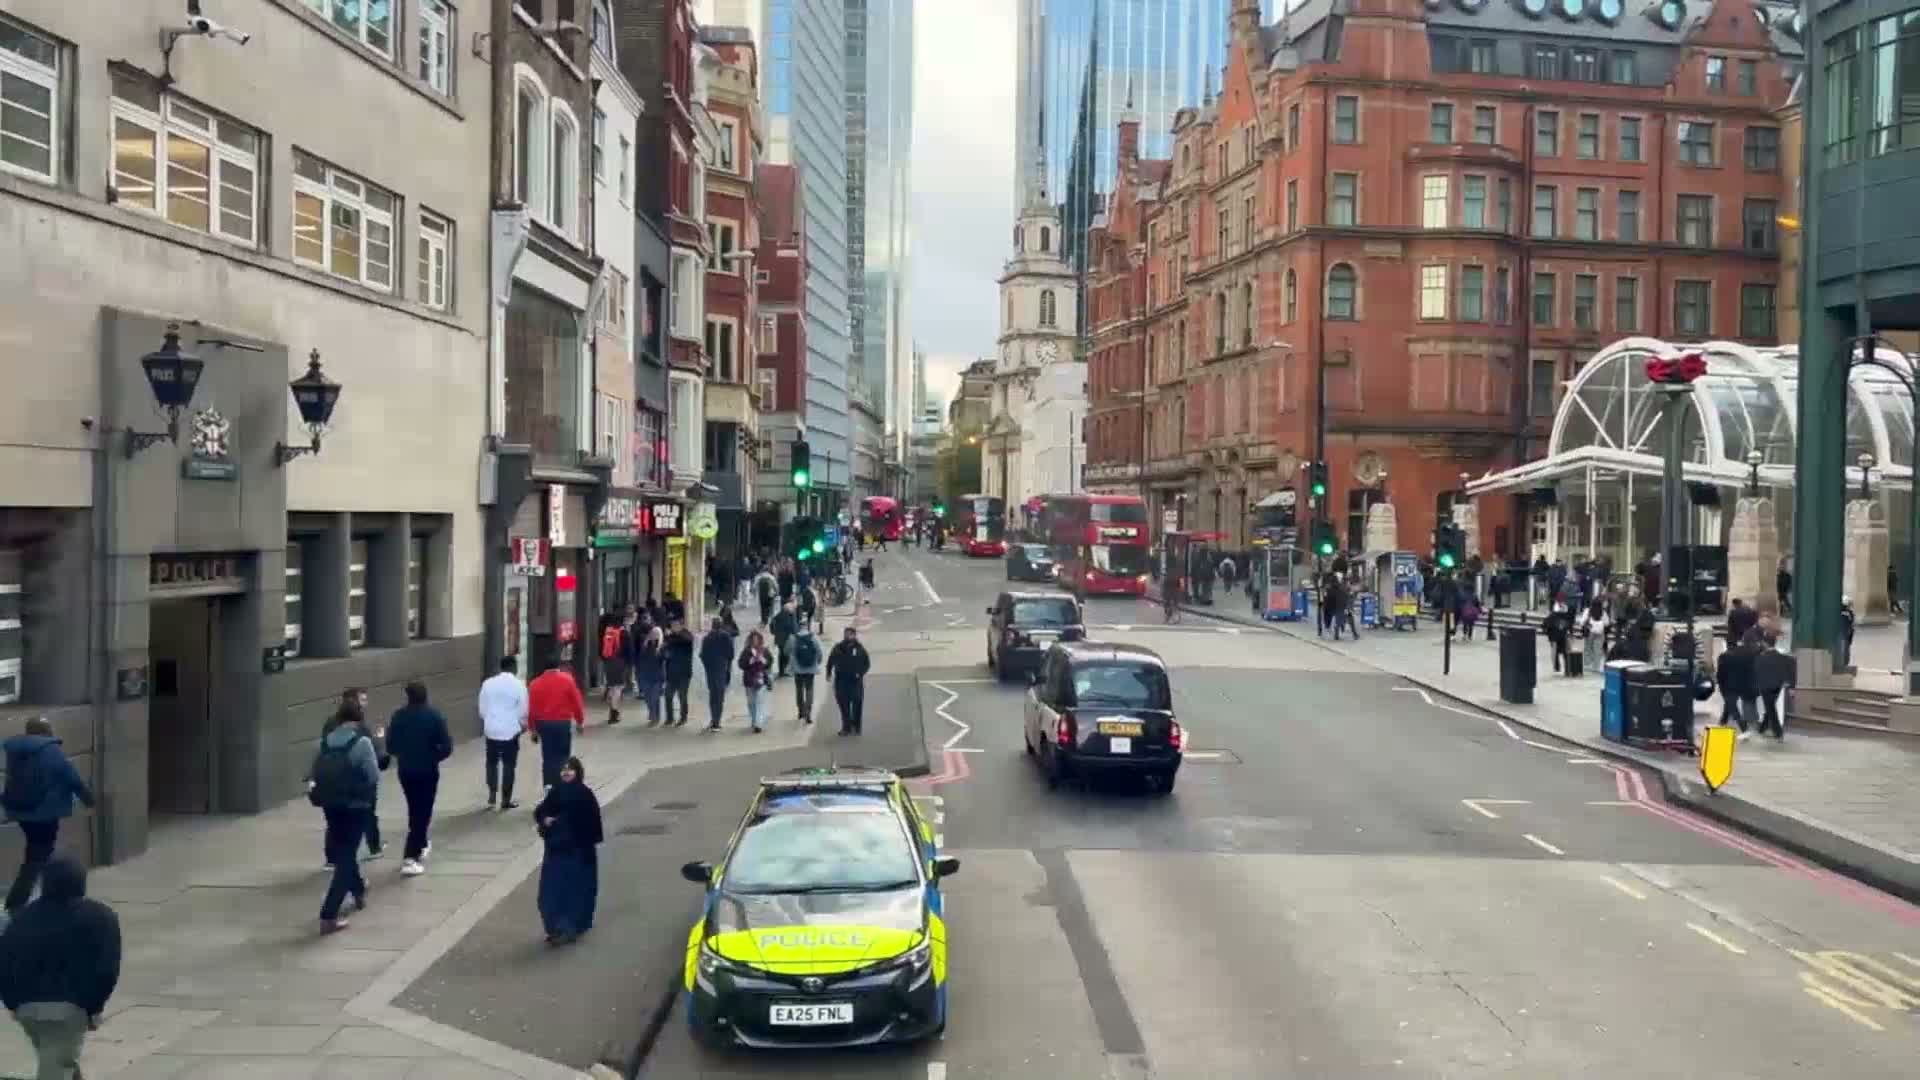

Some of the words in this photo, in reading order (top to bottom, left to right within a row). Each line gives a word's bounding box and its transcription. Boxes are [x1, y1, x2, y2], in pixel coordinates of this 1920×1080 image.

[156, 560, 235, 582] POLICE
[518, 566, 541, 576] KFC
[760, 931, 868, 948] POLICE
[776, 1007, 814, 1022] EA25
[818, 1006, 846, 1021] FNL
